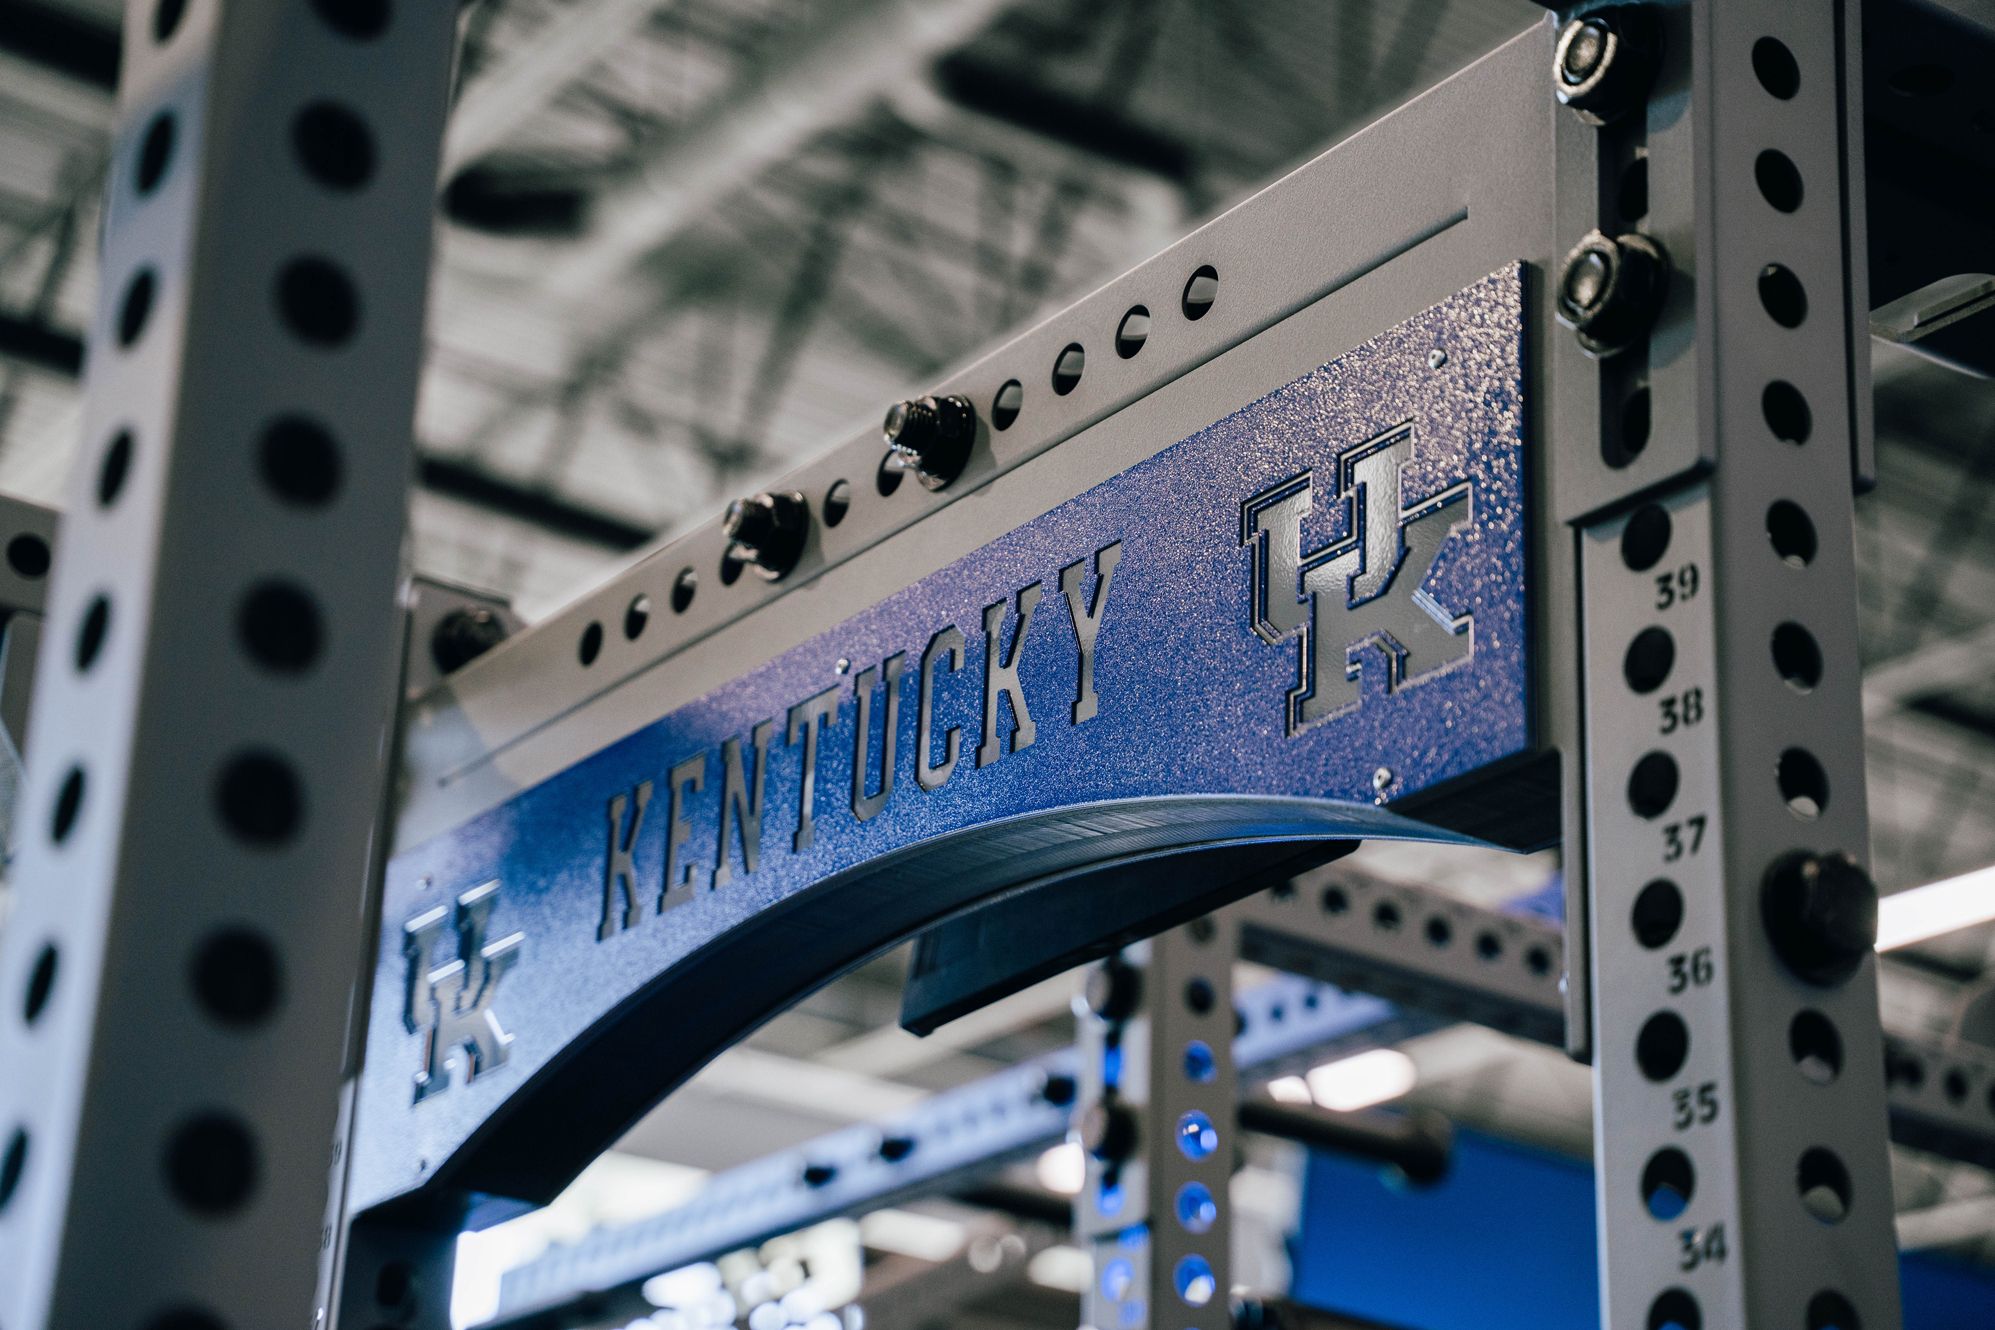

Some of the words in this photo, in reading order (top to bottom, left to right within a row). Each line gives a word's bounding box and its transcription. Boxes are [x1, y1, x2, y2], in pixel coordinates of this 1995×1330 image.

[1240, 418, 1474, 738] UK
[1655, 563, 1700, 609] 39
[1659, 687, 1704, 735] 38
[597, 539, 1123, 942] KENTUCKY
[1663, 814, 1709, 863] 37
[1668, 946, 1714, 994] 36
[1673, 1082, 1719, 1130] 35
[1679, 1223, 1726, 1270] 34
